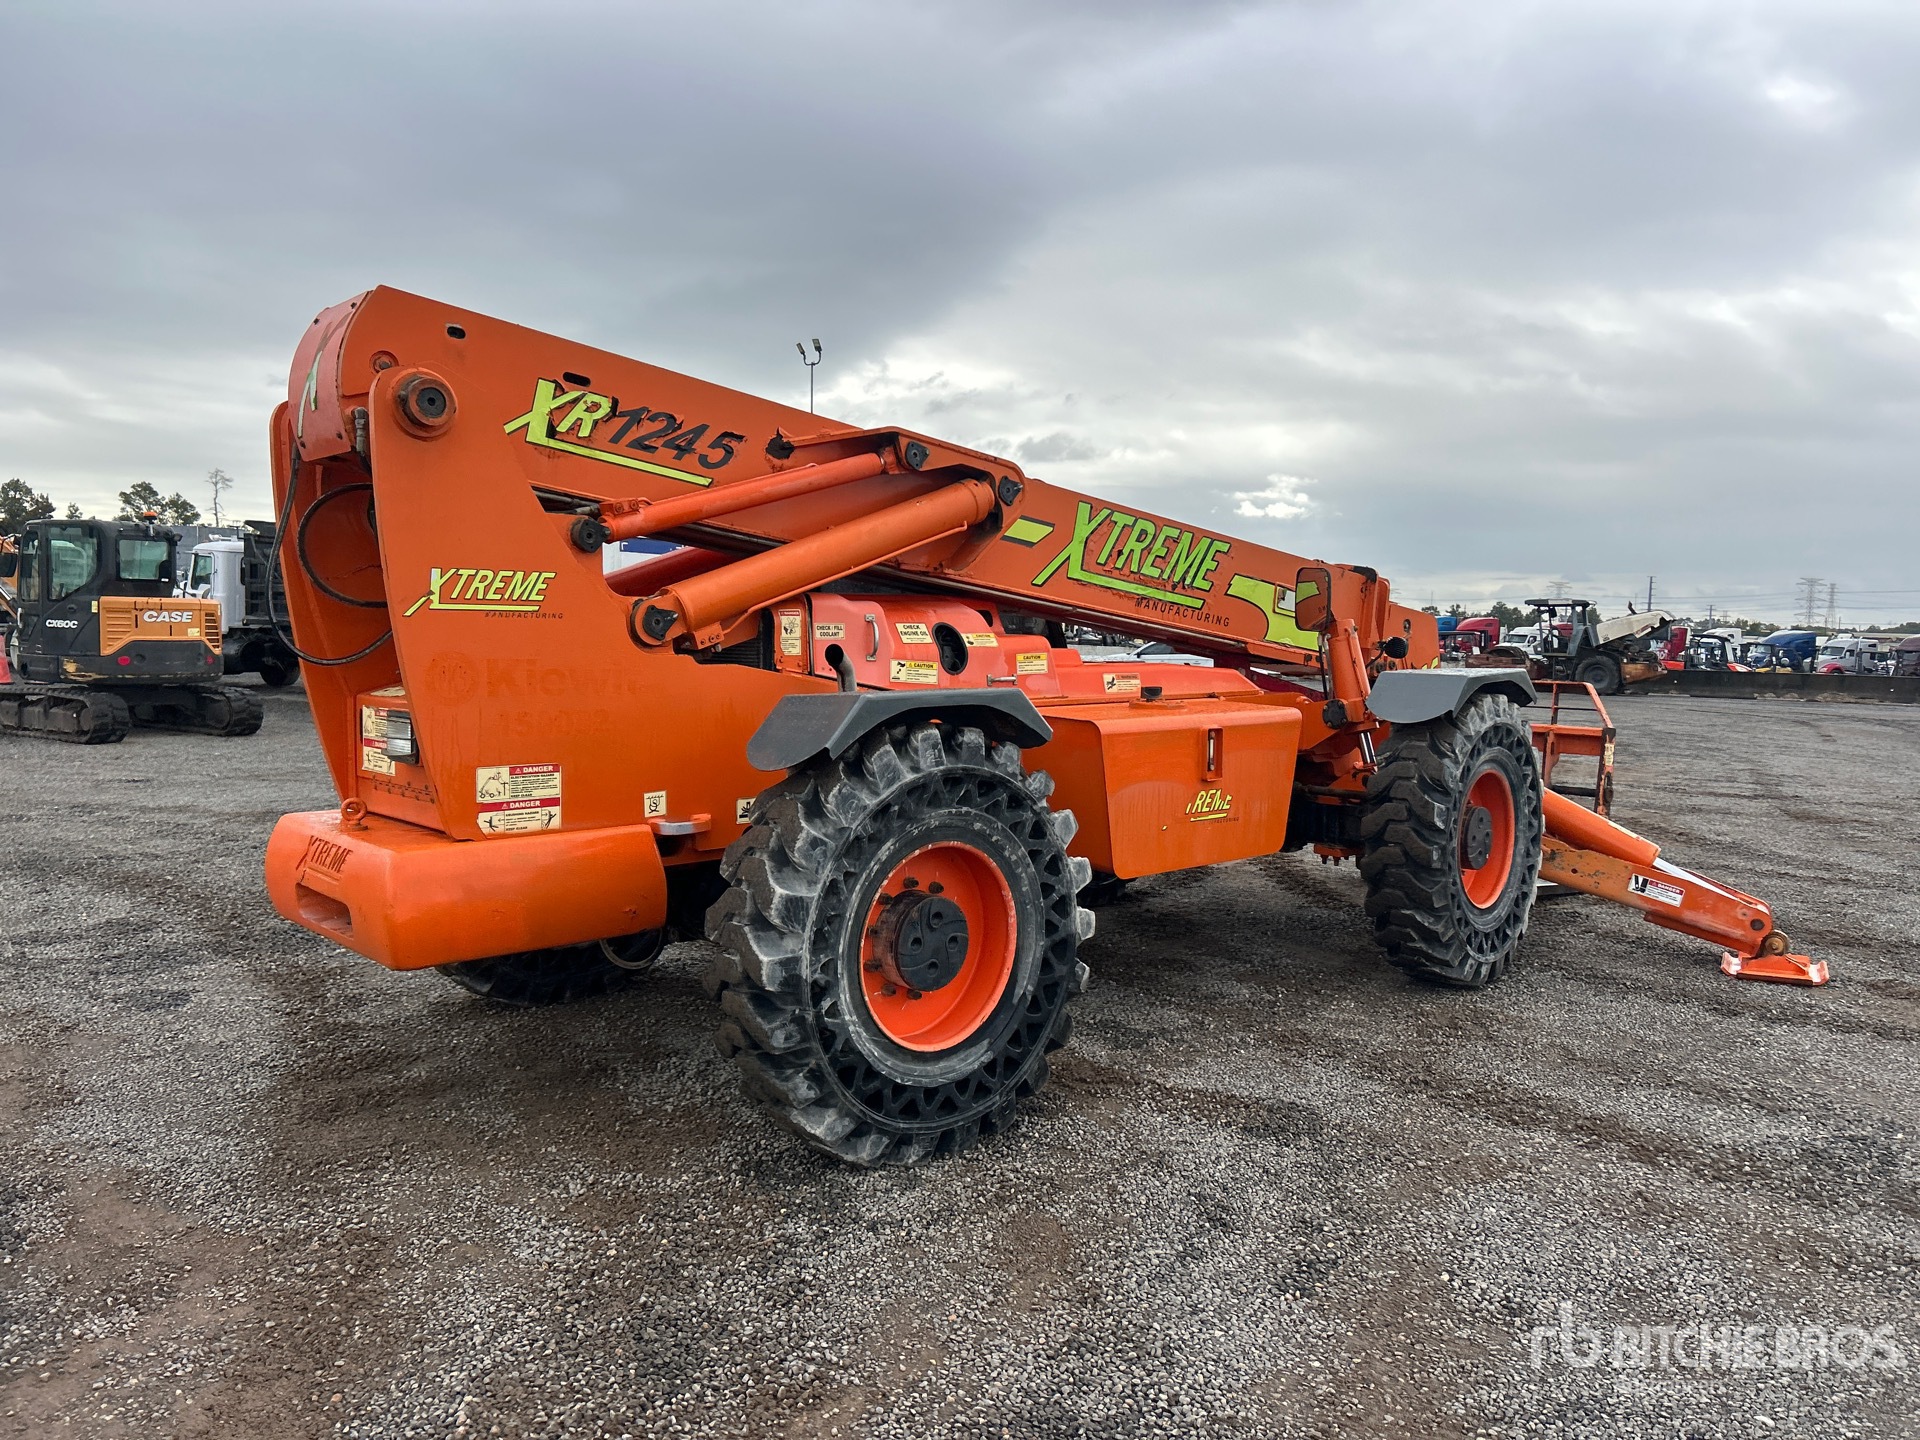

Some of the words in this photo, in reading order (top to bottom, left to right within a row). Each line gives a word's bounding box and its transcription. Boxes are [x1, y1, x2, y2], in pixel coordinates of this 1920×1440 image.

[1031, 500, 1231, 608] XTREME
[402, 567, 556, 617] XTREME
[45, 619, 79, 629] CX60C
[143, 610, 193, 623] CASE
[1134, 598, 1230, 628] MANUFACTURING
[510, 800, 540, 808] DANGER
[296, 834, 353, 875] XTREME
